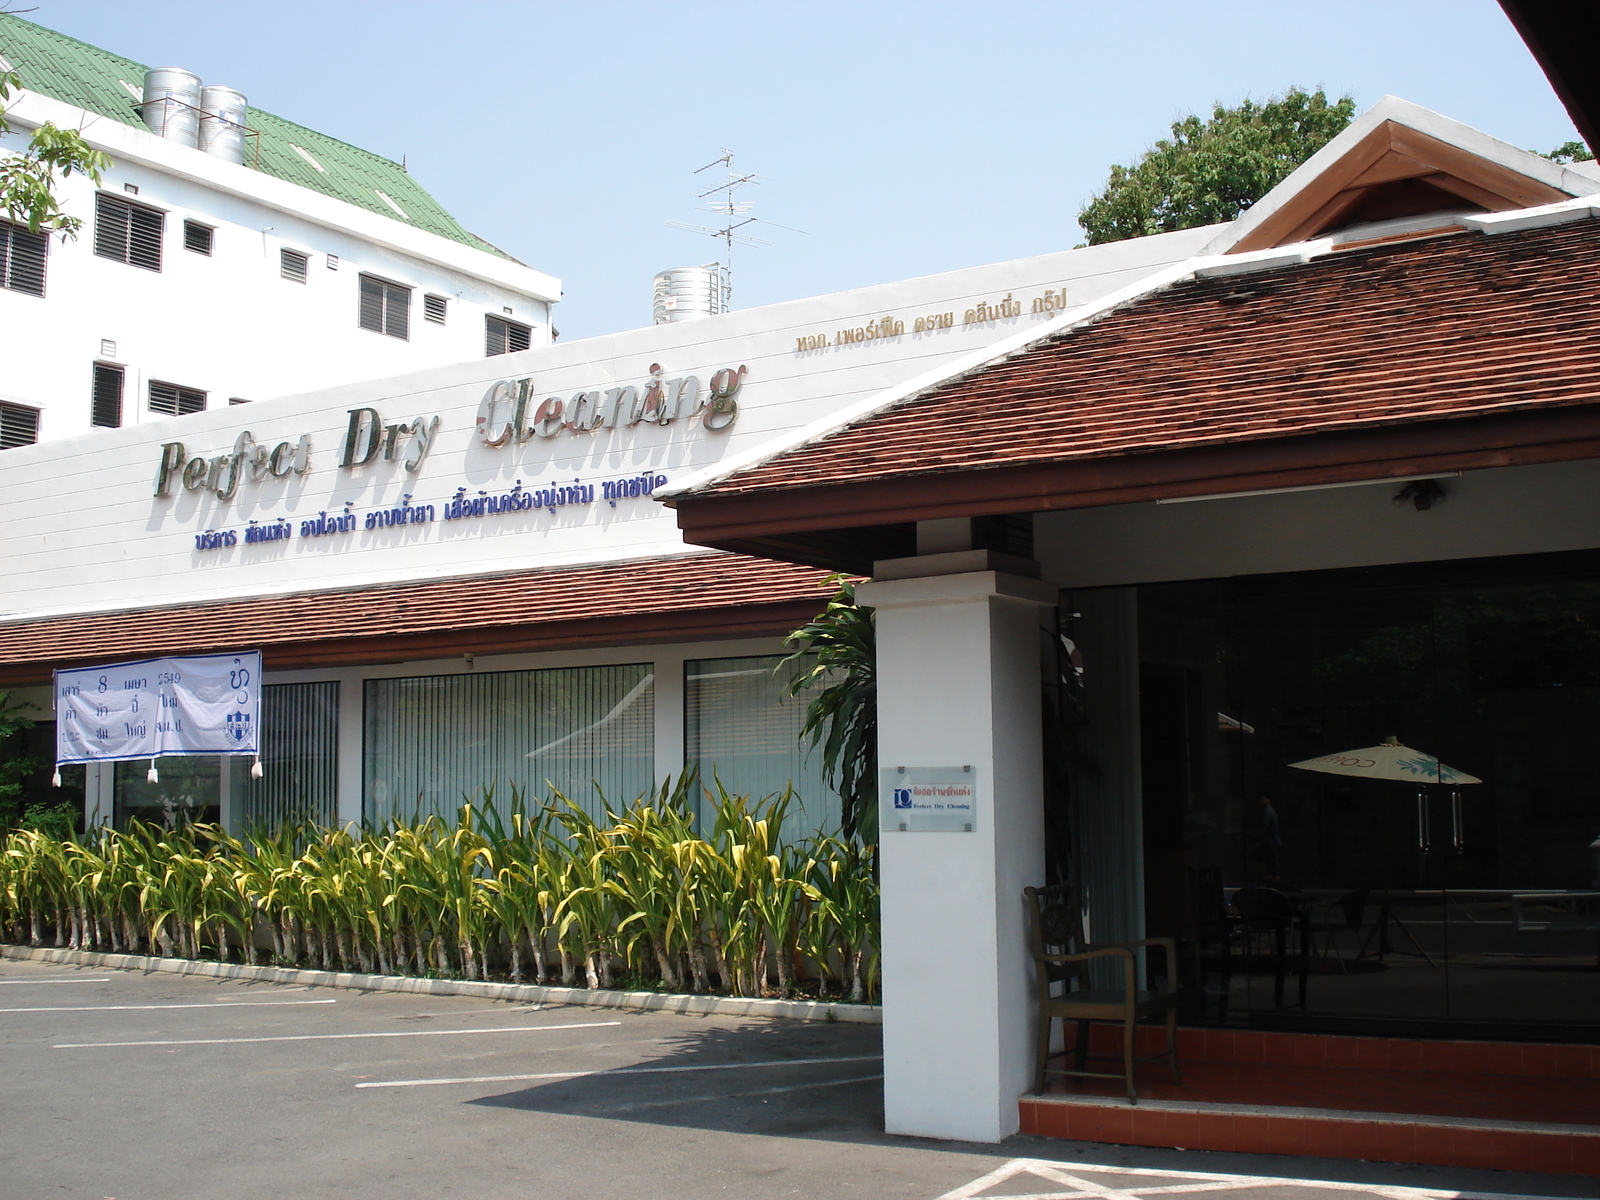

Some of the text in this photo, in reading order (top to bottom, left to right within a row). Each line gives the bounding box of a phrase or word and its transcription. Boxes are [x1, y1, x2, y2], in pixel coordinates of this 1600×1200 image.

[913, 311, 954, 333] ดราย
[153, 361, 749, 500] Perfect Dry Cleaning
[195, 530, 238, 551] บริการ
[244, 519, 293, 544] ซักแห้ง
[300, 501, 357, 538] อบไอน้ำ
[364, 493, 436, 530] อาบน้ำยา
[444, 479, 594, 522] เสื้อผ้าเครื่องนุ่งห่ม
[98, 675, 108, 694] 8
[124, 677, 147, 691] เมษา
[157, 672, 182, 685] 2549
[124, 719, 147, 739] ใหญ่
